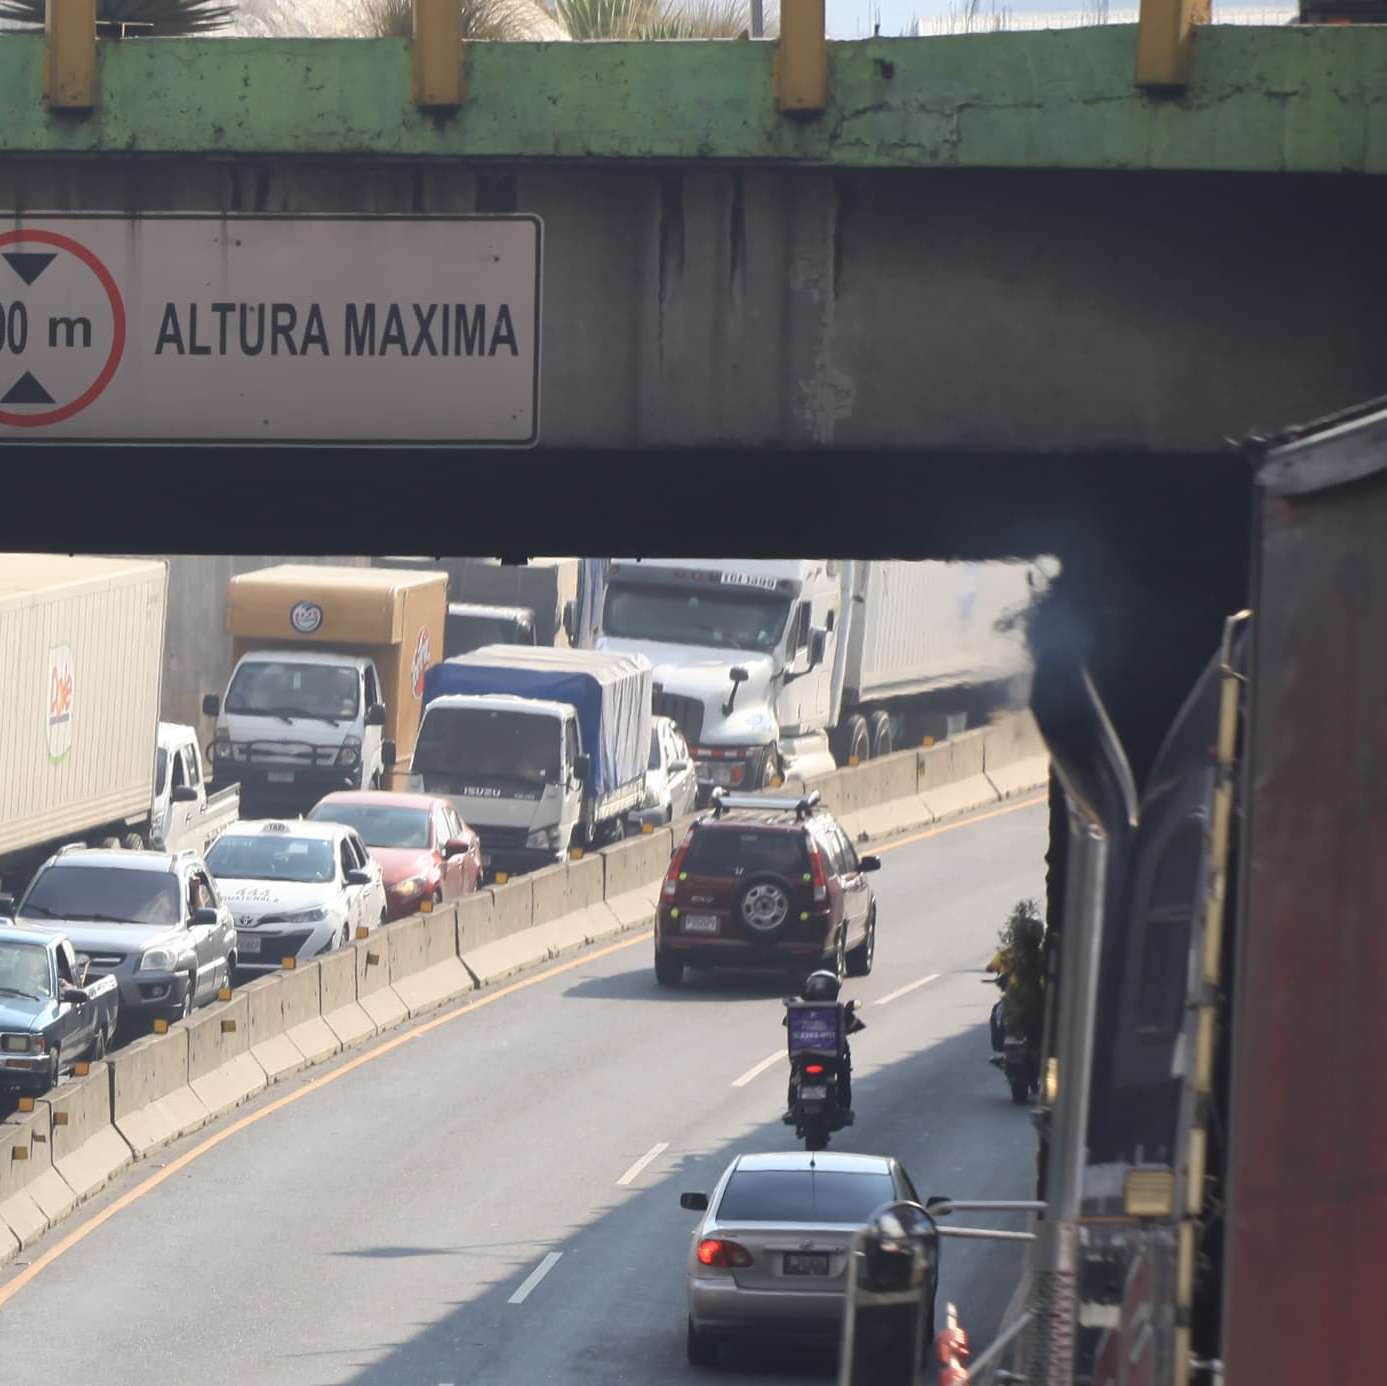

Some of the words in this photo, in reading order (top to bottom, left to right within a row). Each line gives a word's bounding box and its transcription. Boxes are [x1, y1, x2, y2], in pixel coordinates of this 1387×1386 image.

[48, 316, 92, 348] m
[154, 302, 330, 356] ALTURA
[344, 303, 520, 357] MAXIMA
